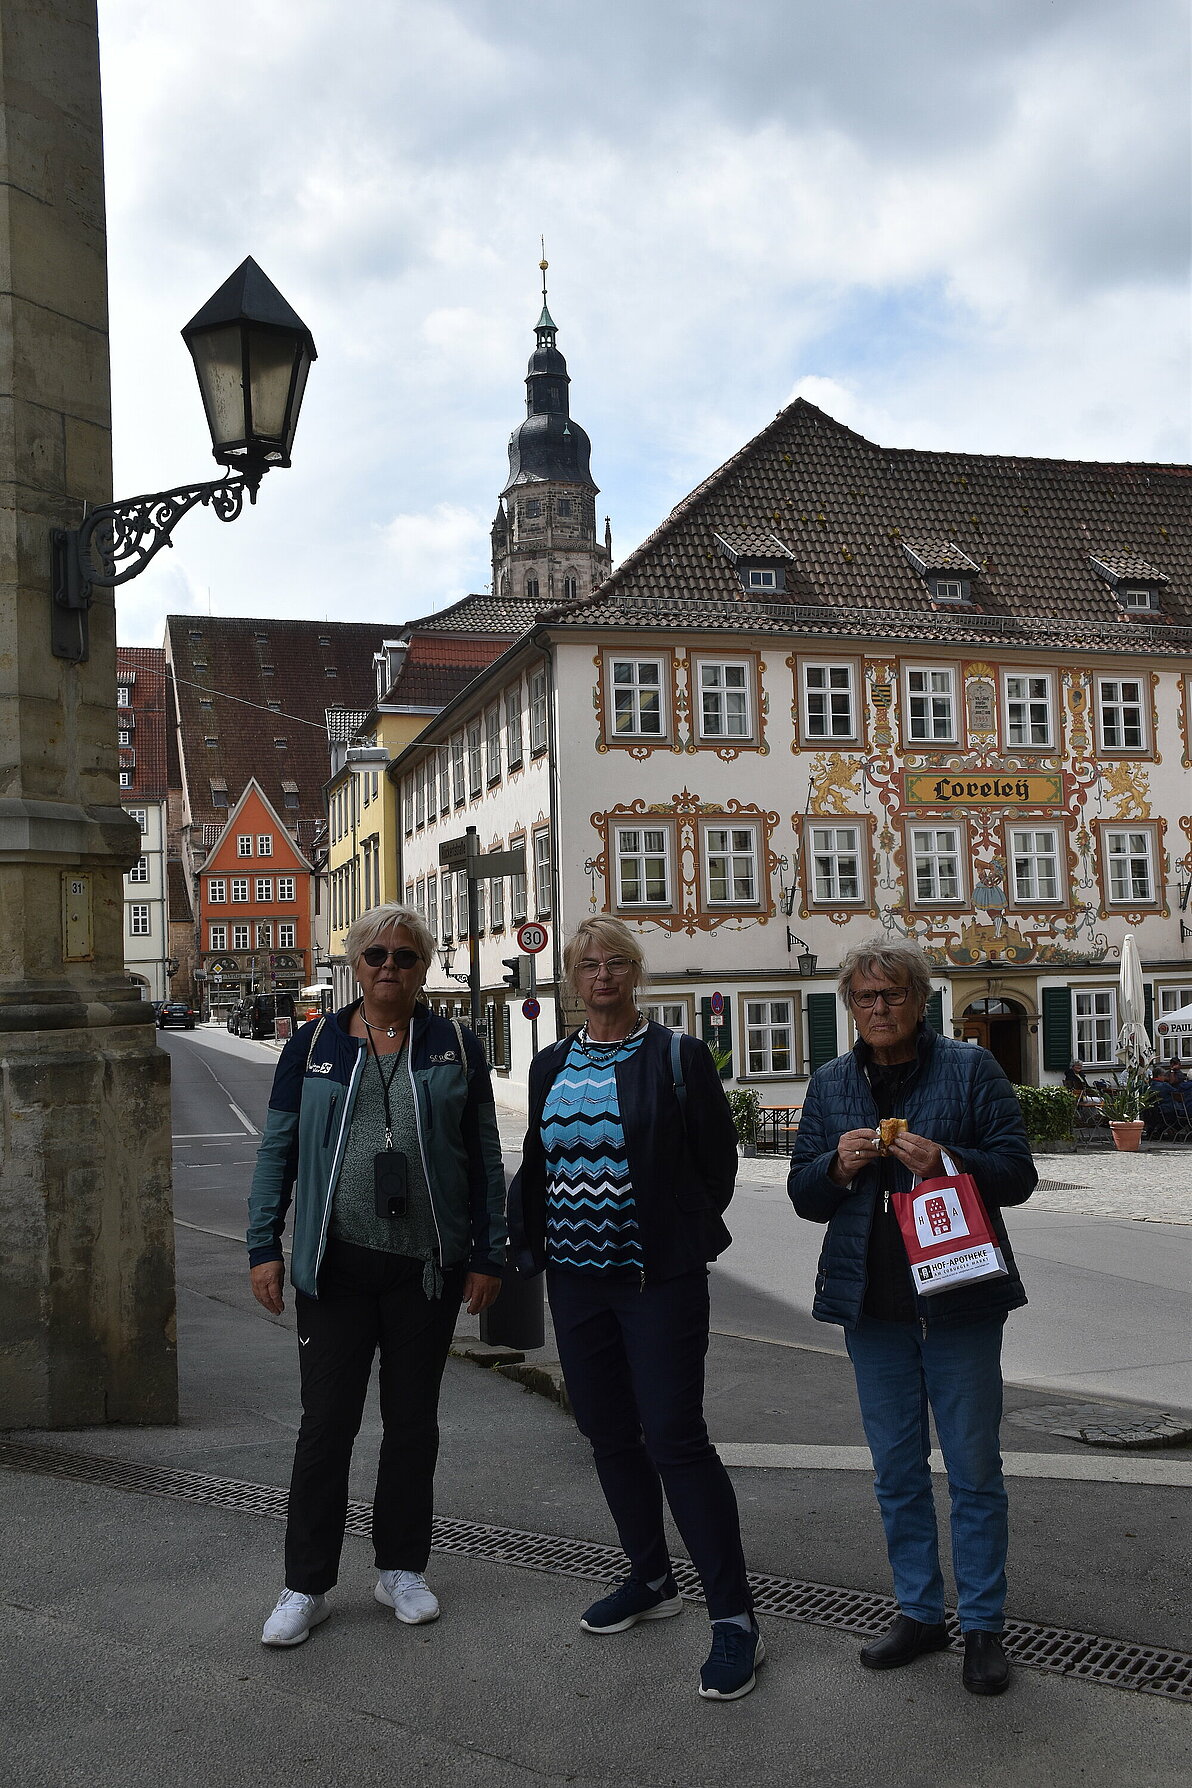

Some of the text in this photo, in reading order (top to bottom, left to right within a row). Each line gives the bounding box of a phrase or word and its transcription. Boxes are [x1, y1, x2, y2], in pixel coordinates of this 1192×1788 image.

[72, 882, 82, 894] 31
[523, 931, 542, 946] 30
[918, 1207, 959, 1226] H A
[931, 1249, 988, 1272] HOF-APOTHEKE
